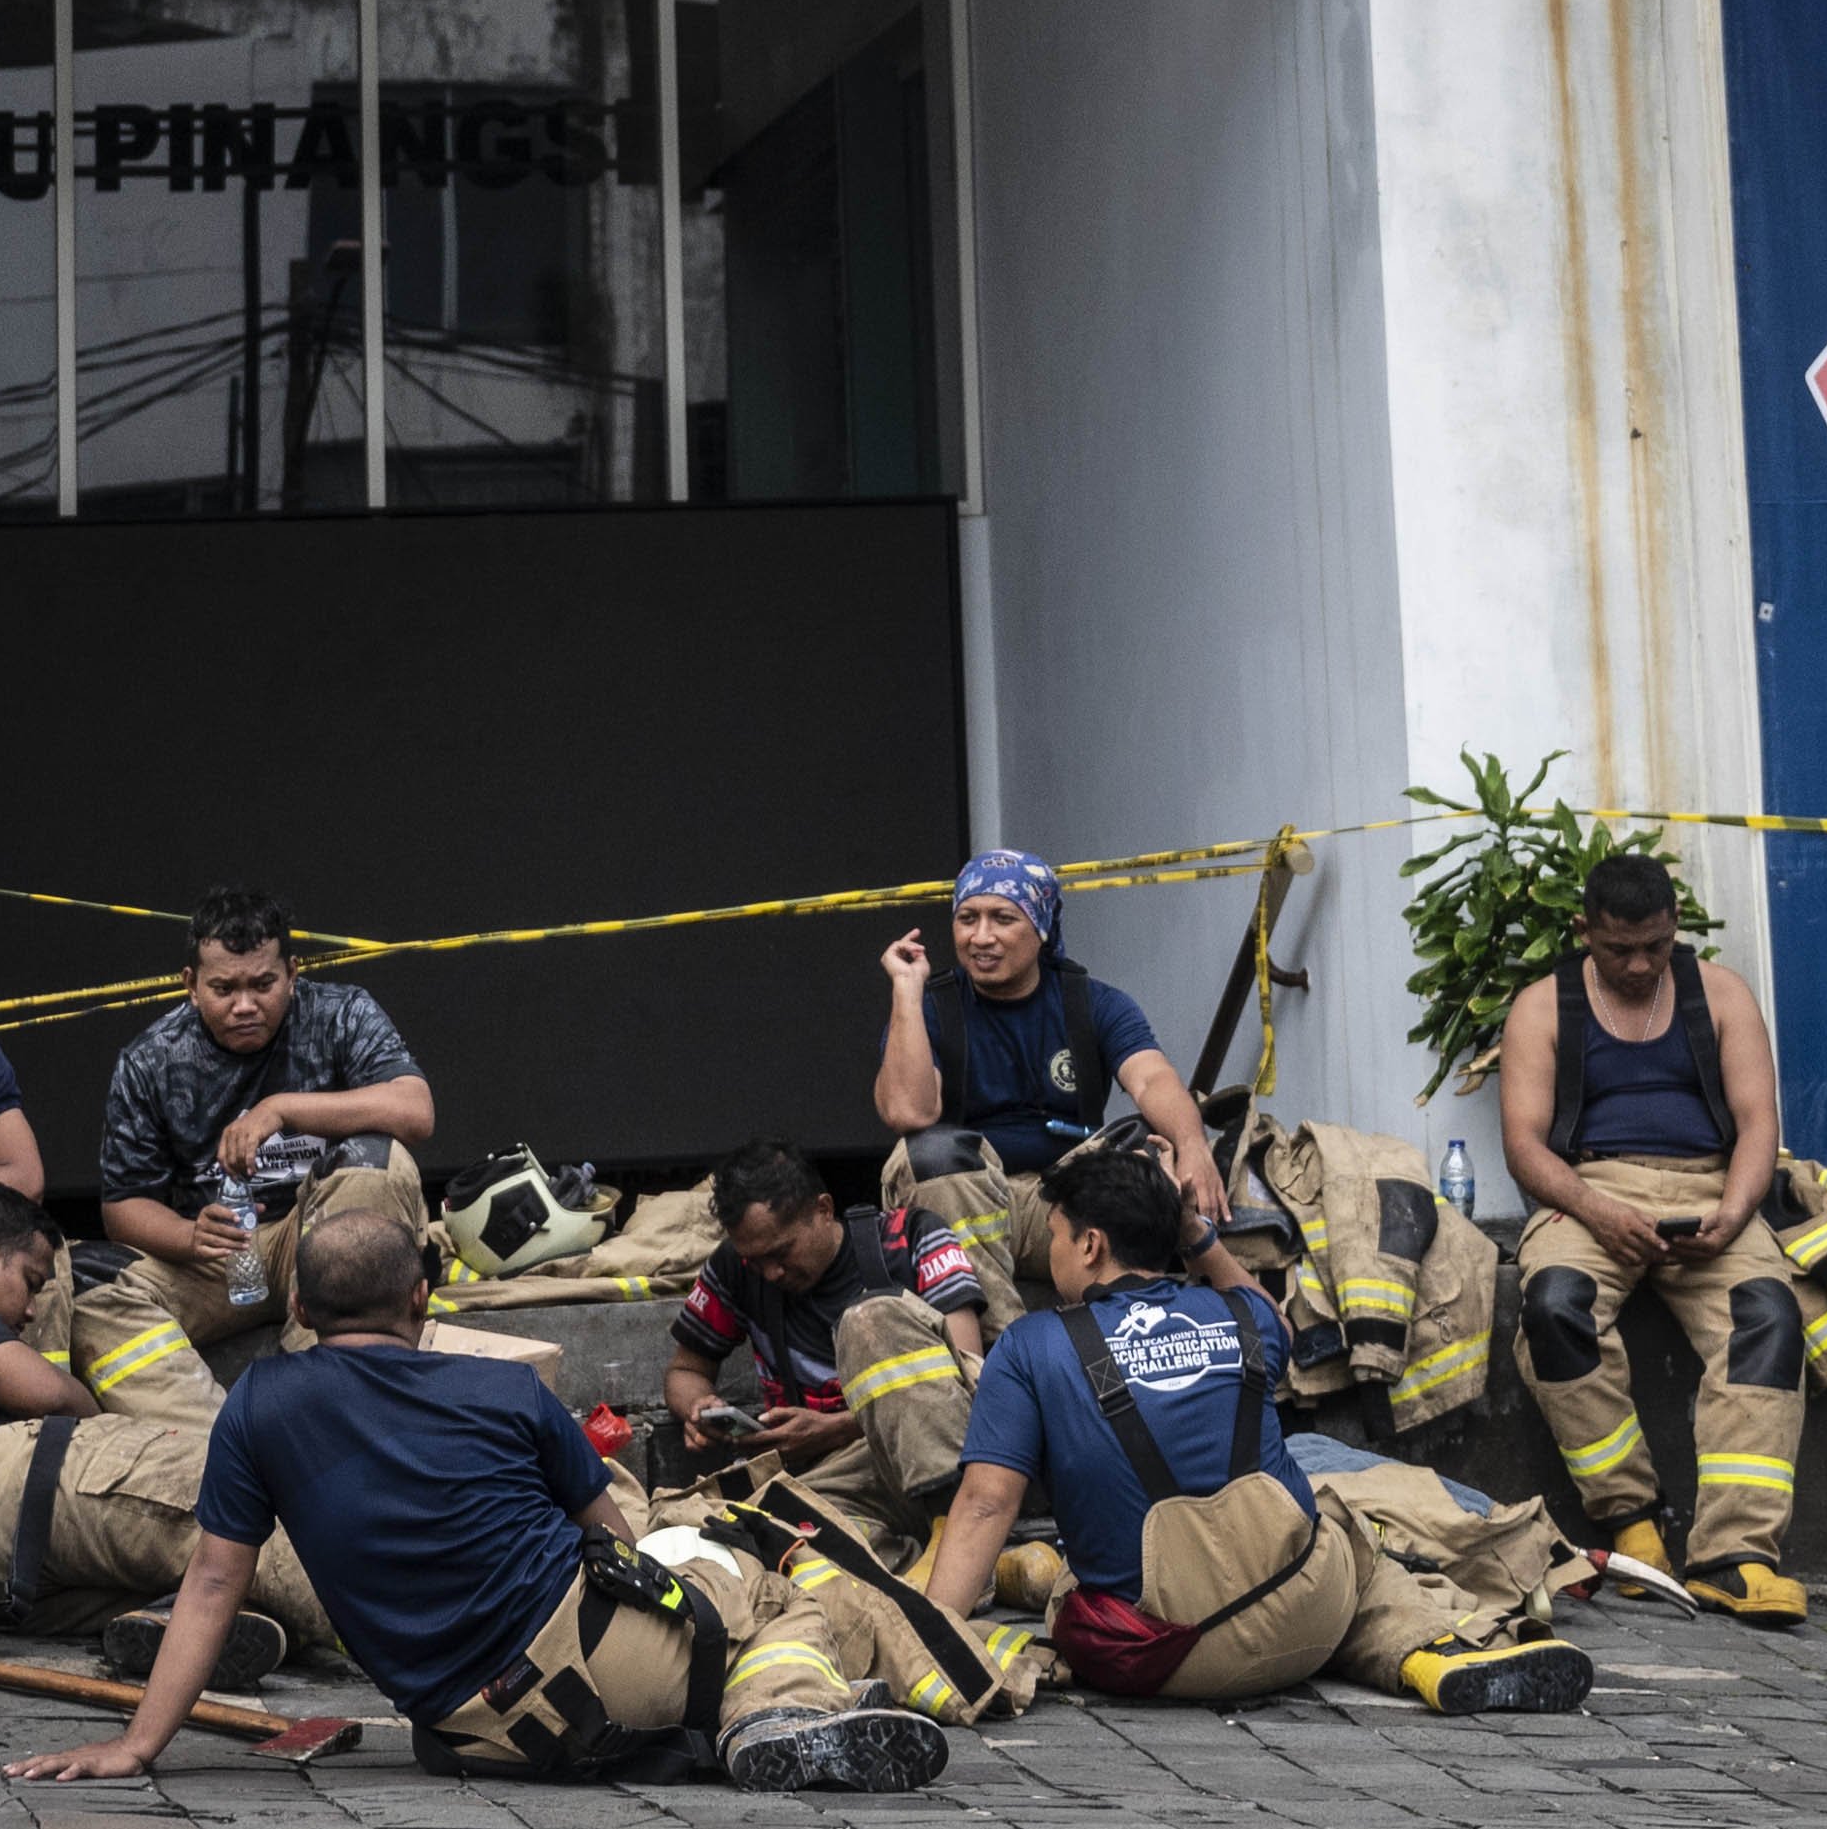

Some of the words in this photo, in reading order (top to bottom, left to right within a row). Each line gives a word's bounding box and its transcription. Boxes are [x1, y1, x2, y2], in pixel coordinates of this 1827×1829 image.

[1148, 1335, 1241, 1359] EXTRICATION
[1170, 1331, 1197, 1343] JOINT
[1128, 1351, 1212, 1377] CHALLENGE
